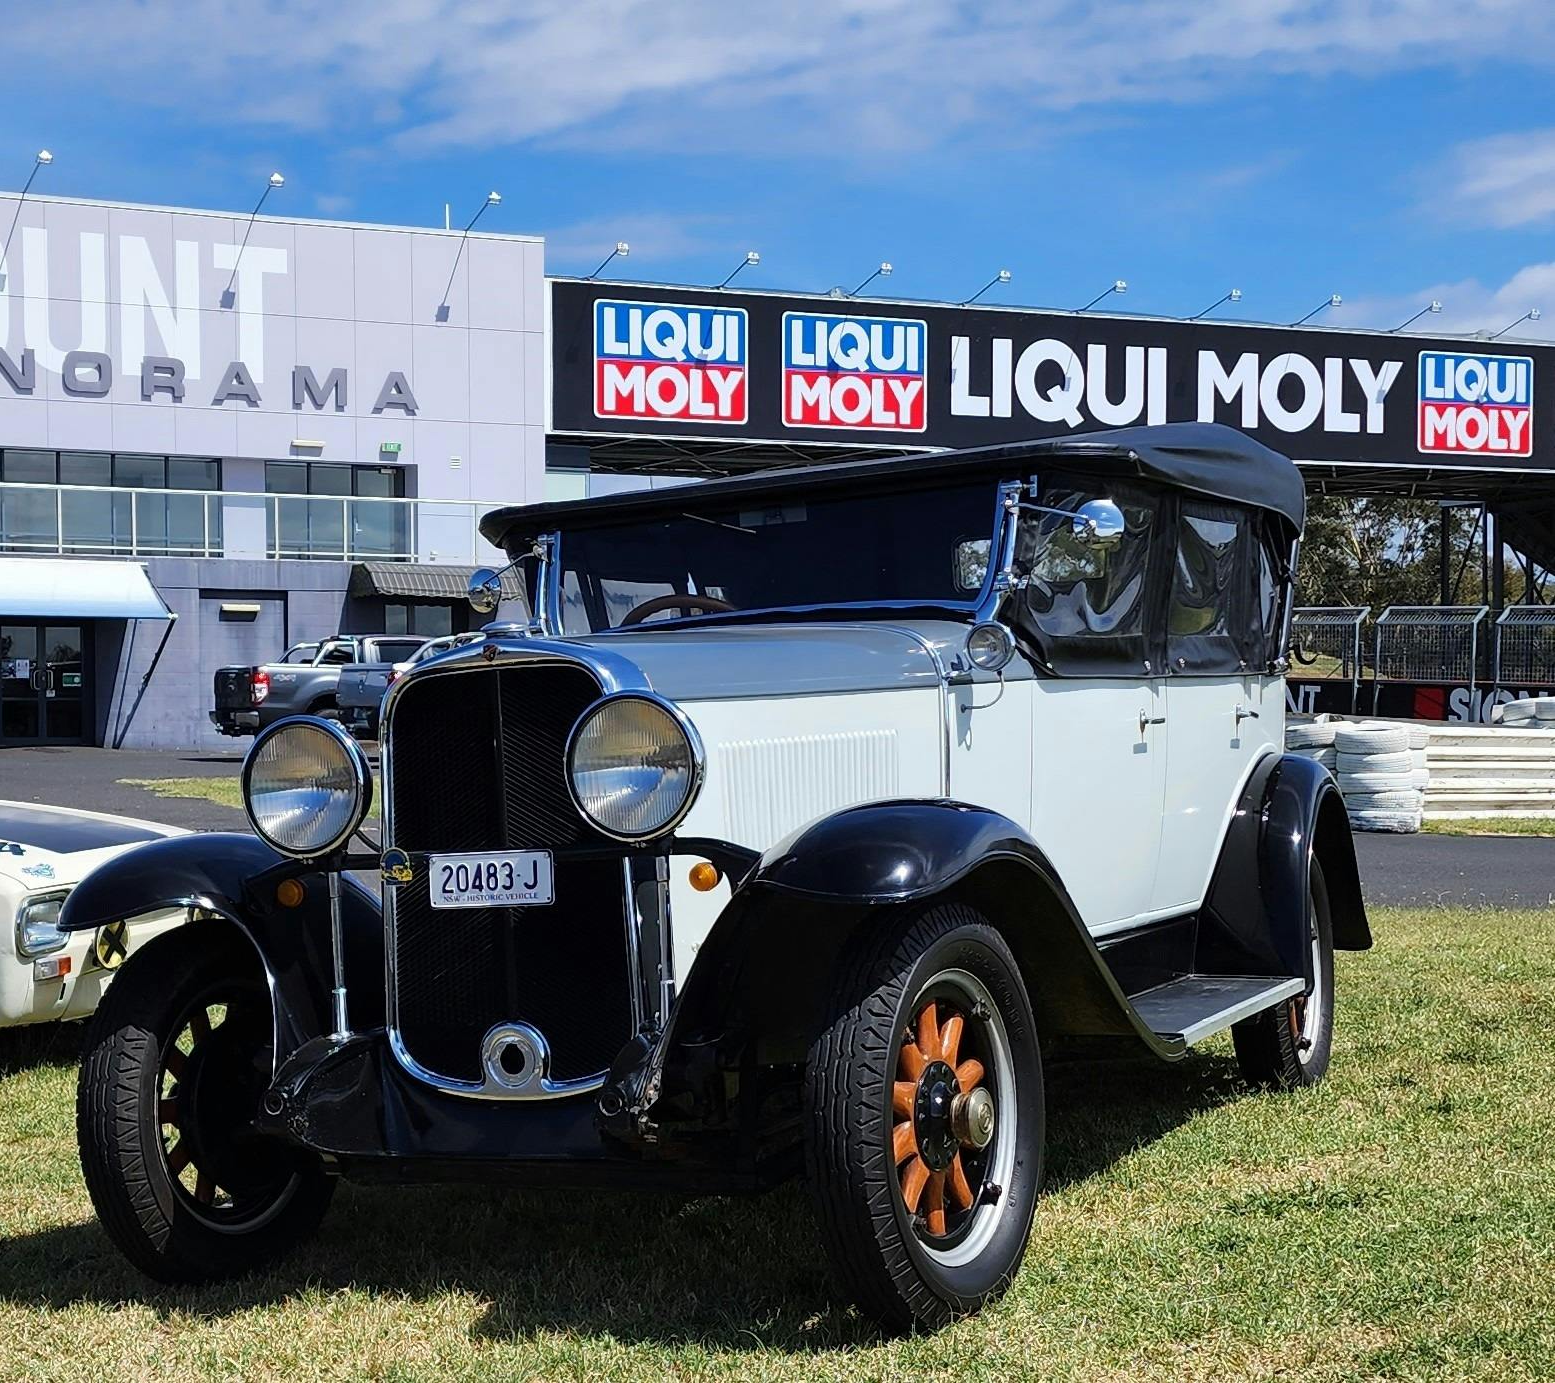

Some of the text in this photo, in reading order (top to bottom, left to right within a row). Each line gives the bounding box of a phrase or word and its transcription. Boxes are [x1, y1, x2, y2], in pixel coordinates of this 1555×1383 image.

[603, 307, 739, 362] LIQUI
[791, 319, 919, 372] LIQUI
[603, 364, 744, 416] MOLY
[791, 375, 923, 424] MOLY
[950, 336, 1404, 434] LIQUI MOLY
[1425, 358, 1527, 403] LIQUI
[1425, 406, 1529, 450] MOLY
[467, 893, 503, 902] HISTORIC
[505, 892, 539, 900] VEHICLE
